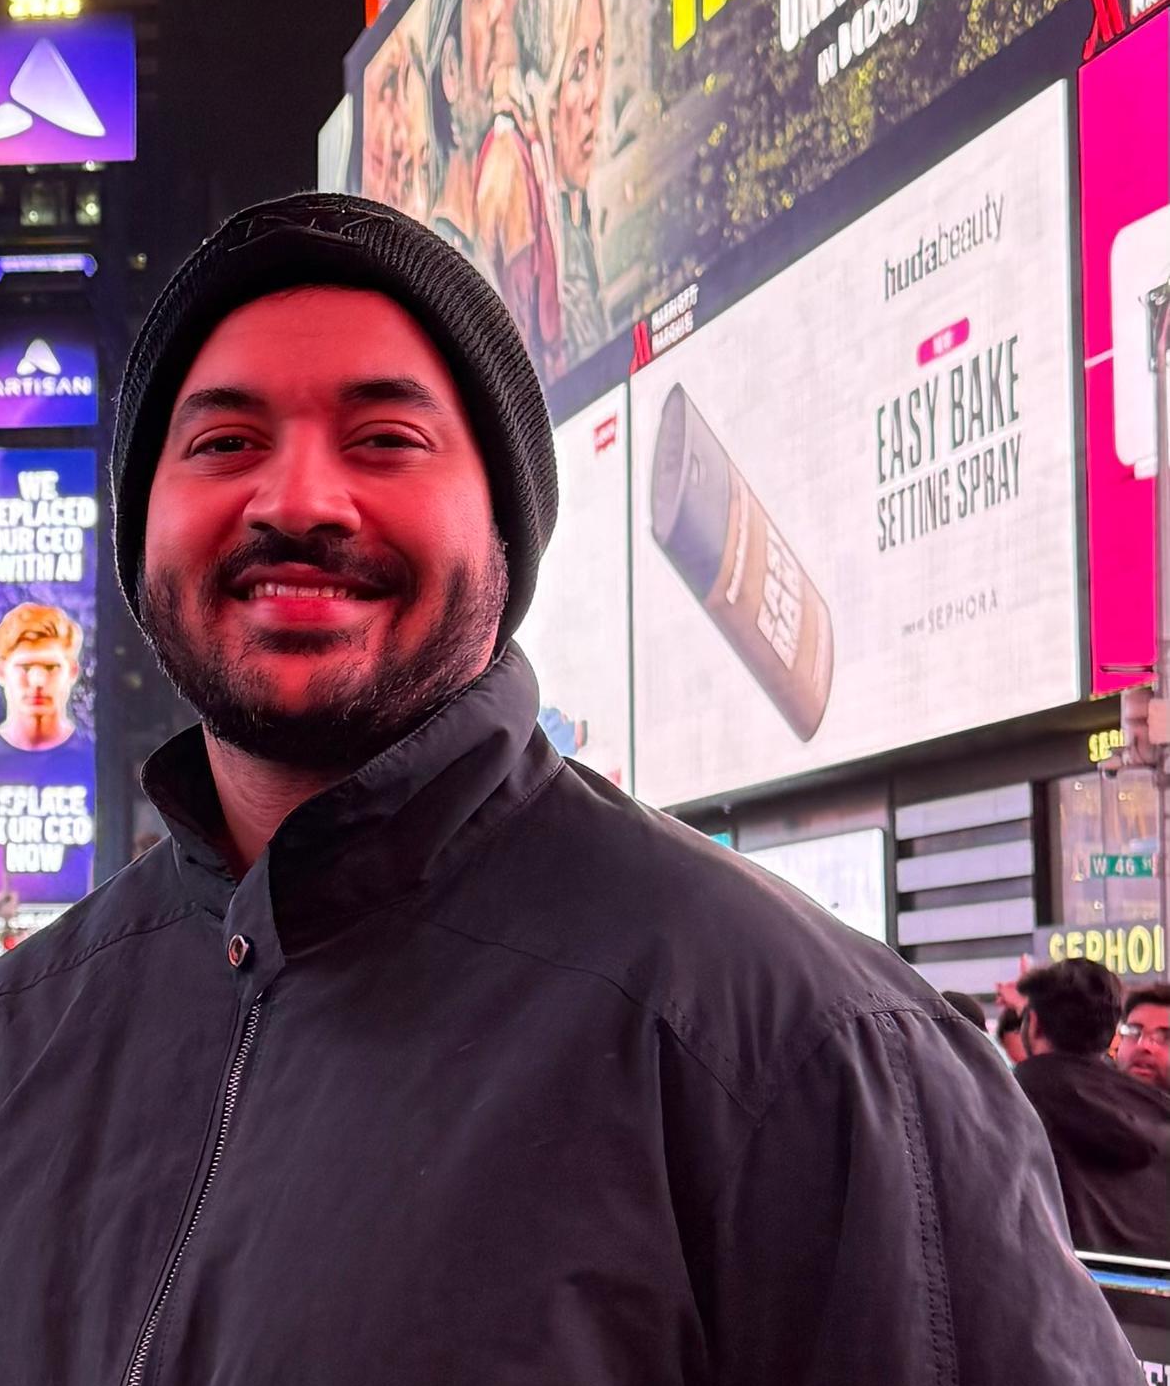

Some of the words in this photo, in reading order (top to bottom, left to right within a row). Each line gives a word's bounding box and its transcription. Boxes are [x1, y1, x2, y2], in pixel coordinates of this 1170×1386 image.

[817, 43, 838, 87] IN
[885, 191, 1004, 303] hudabeauty
[877, 374, 939, 485] EASY
[950, 334, 1020, 450] BAKE
[17, 470, 59, 501] WE
[877, 467, 950, 553] SETTING
[957, 431, 1022, 519] SPRAY
[36, 525, 83, 554] CEO
[56, 553, 83, 582] AI
[927, 586, 998, 635] SEPHORA
[43, 815, 93, 845] CEO
[6, 843, 65, 873] NOW
[1092, 857, 1107, 876] W
[1114, 857, 1136, 876] 46
